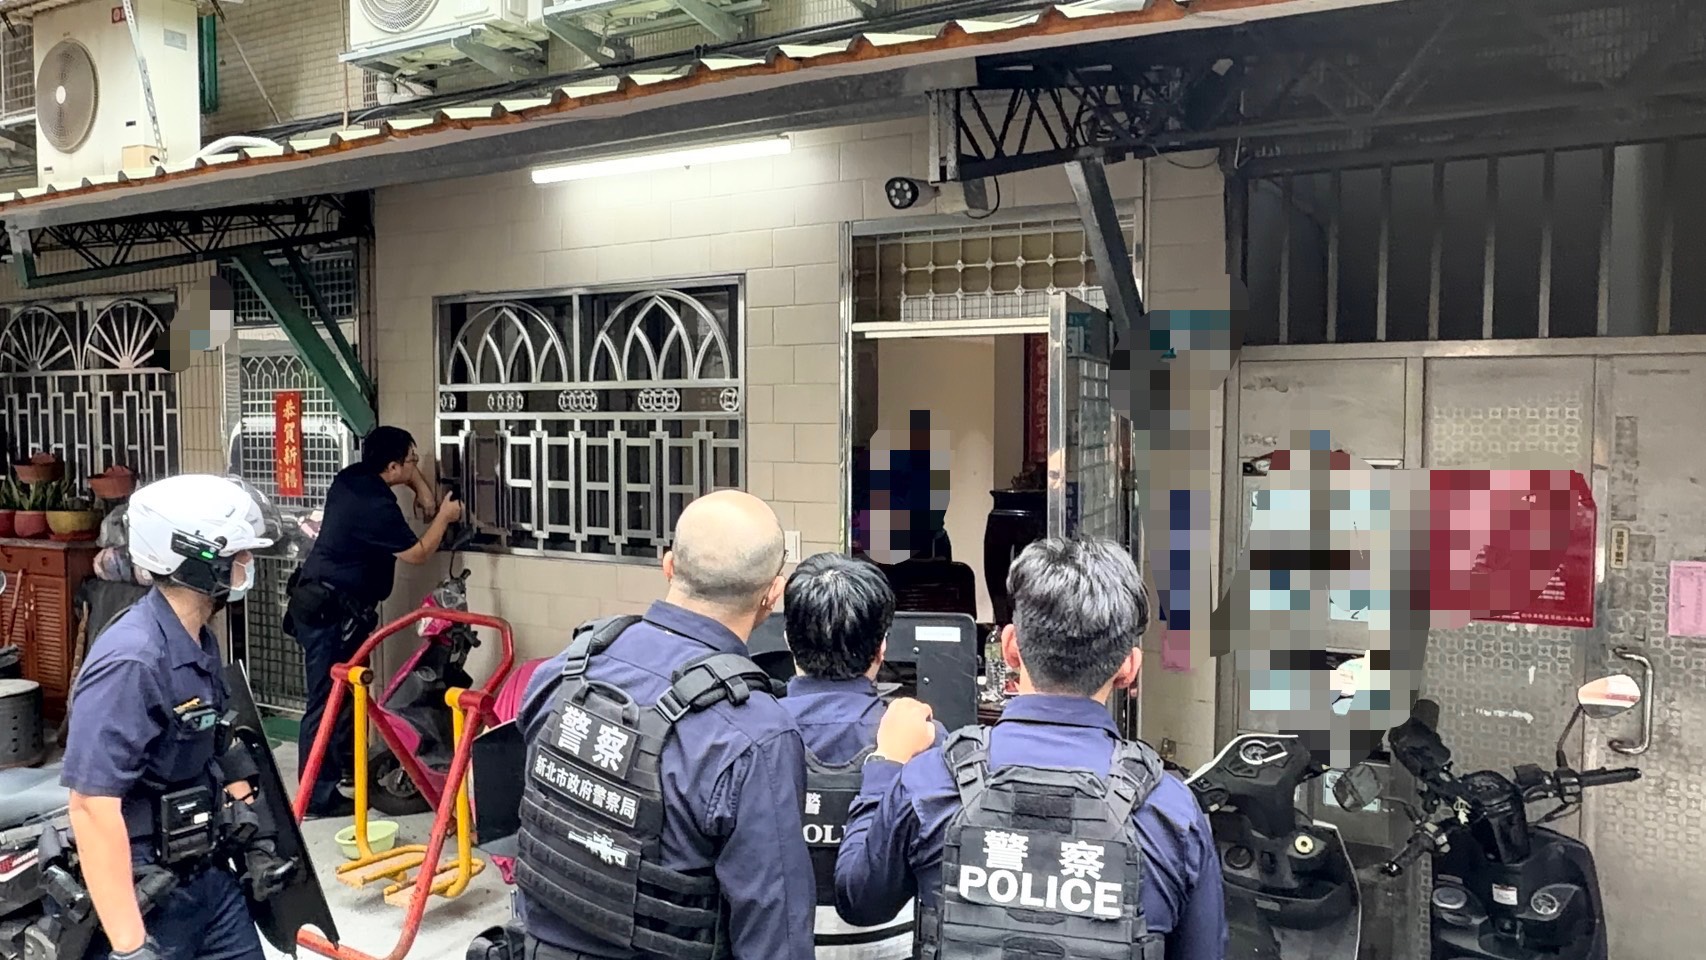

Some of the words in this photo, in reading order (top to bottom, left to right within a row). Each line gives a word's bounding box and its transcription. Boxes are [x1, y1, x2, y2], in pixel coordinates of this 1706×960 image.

[283, 399, 298, 489] 恭賀新禧
[557, 704, 629, 772] 警察
[534, 754, 637, 820] 新北市政府警察局
[802, 823, 847, 844] OL
[982, 829, 1105, 881] 警察
[958, 864, 1122, 918] POLICE
